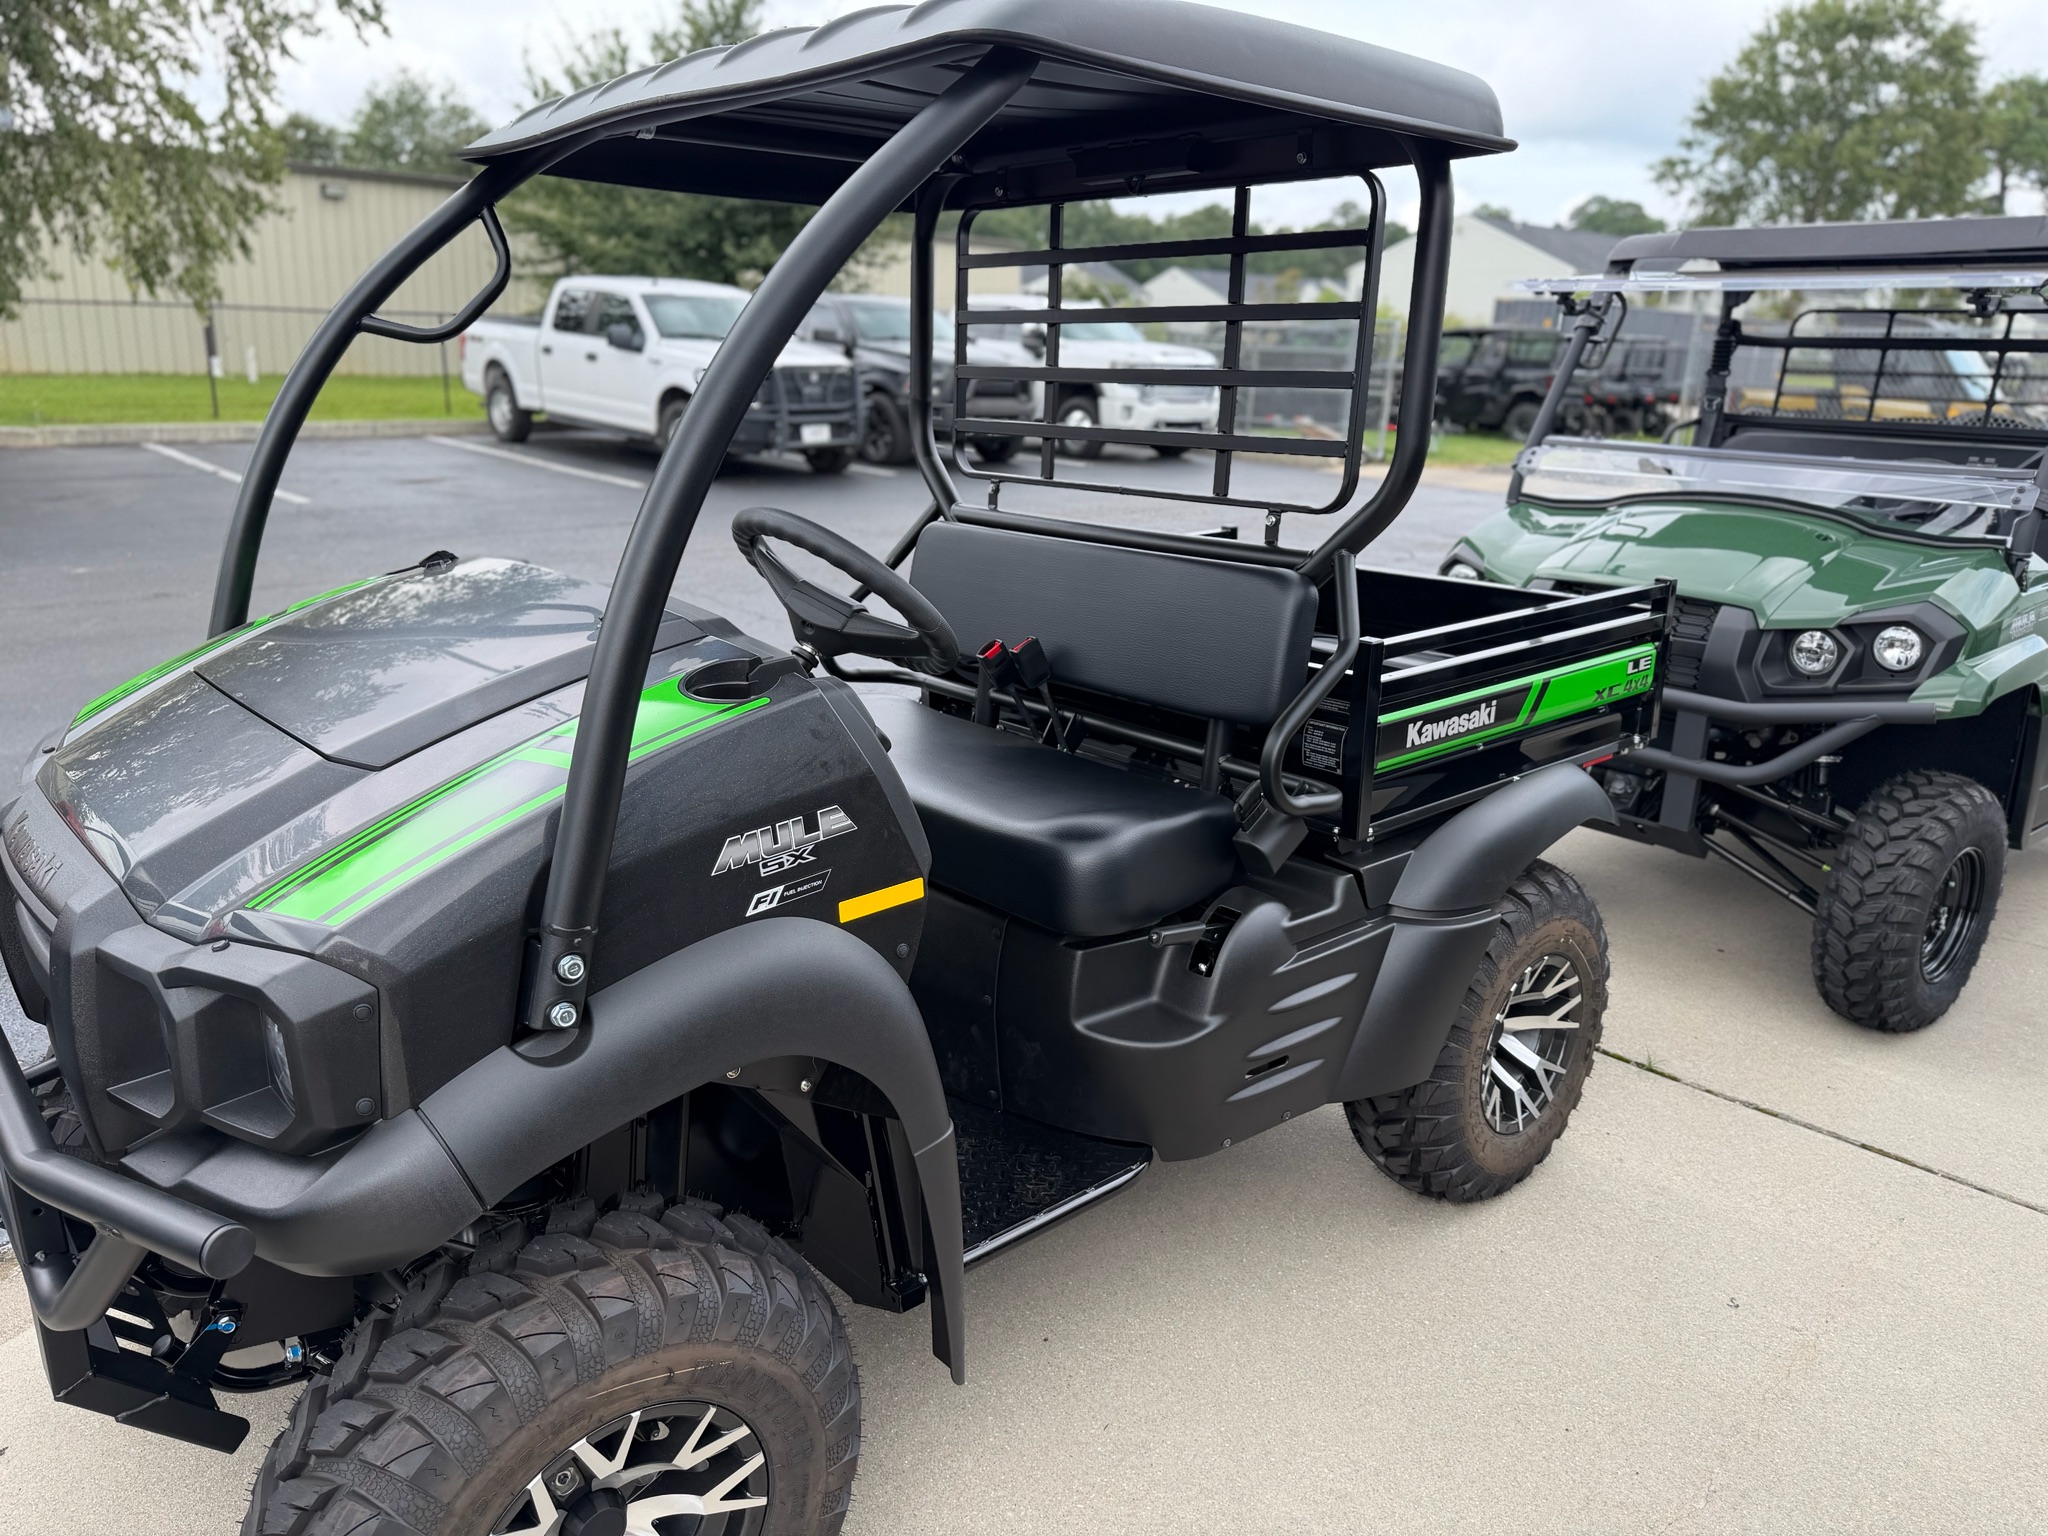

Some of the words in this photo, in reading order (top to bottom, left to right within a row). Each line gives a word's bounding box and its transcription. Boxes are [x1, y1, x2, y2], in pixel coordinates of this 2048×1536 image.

[1627, 656, 1652, 675] LE
[1623, 674, 1649, 693] 4x4
[1406, 700, 1497, 749] Kawasaki
[5, 810, 64, 894] Kawasaki
[711, 805, 858, 876] MULE
[759, 844, 817, 877] SX
[783, 889, 797, 897] FUEL
[797, 880, 823, 892] INJECTION
